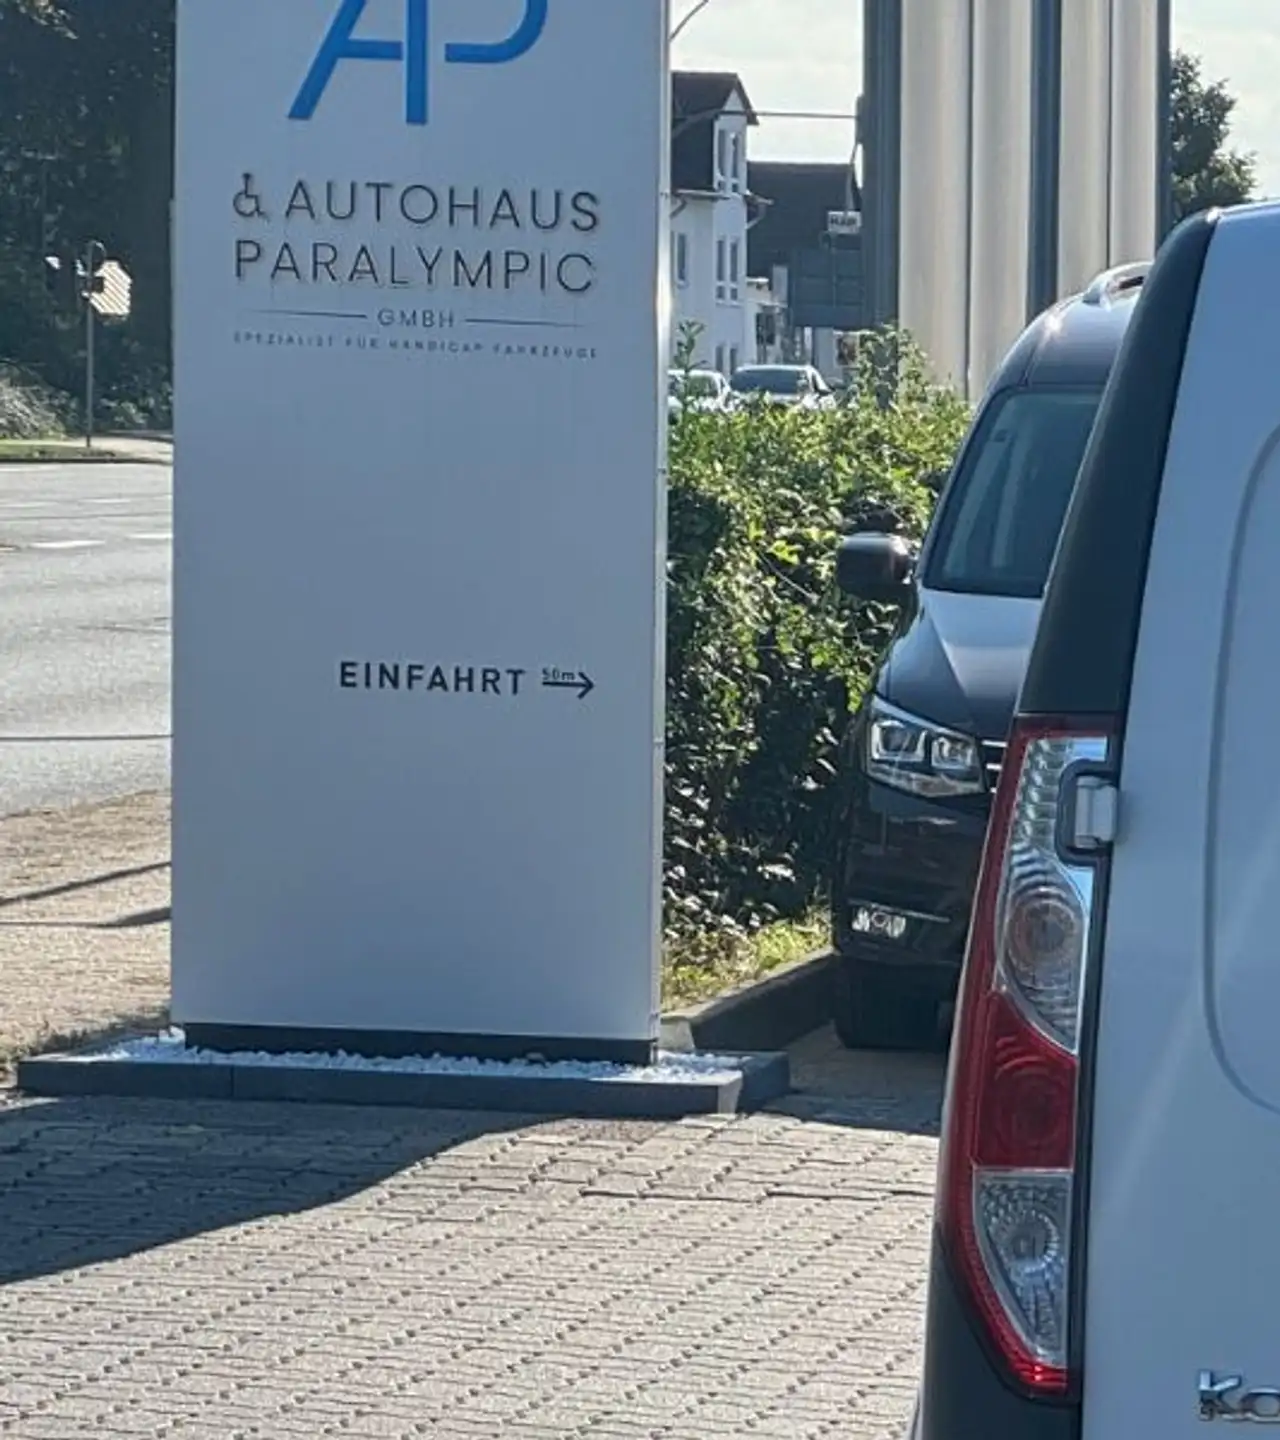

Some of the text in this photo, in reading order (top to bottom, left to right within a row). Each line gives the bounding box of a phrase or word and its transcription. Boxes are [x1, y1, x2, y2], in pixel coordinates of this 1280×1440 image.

[285, 180, 600, 232] AUTOHAUS
[234, 240, 596, 292] PARALYMPIC
[377, 309, 455, 328] GMBH
[340, 661, 576, 696] EINFAHRT 50m
